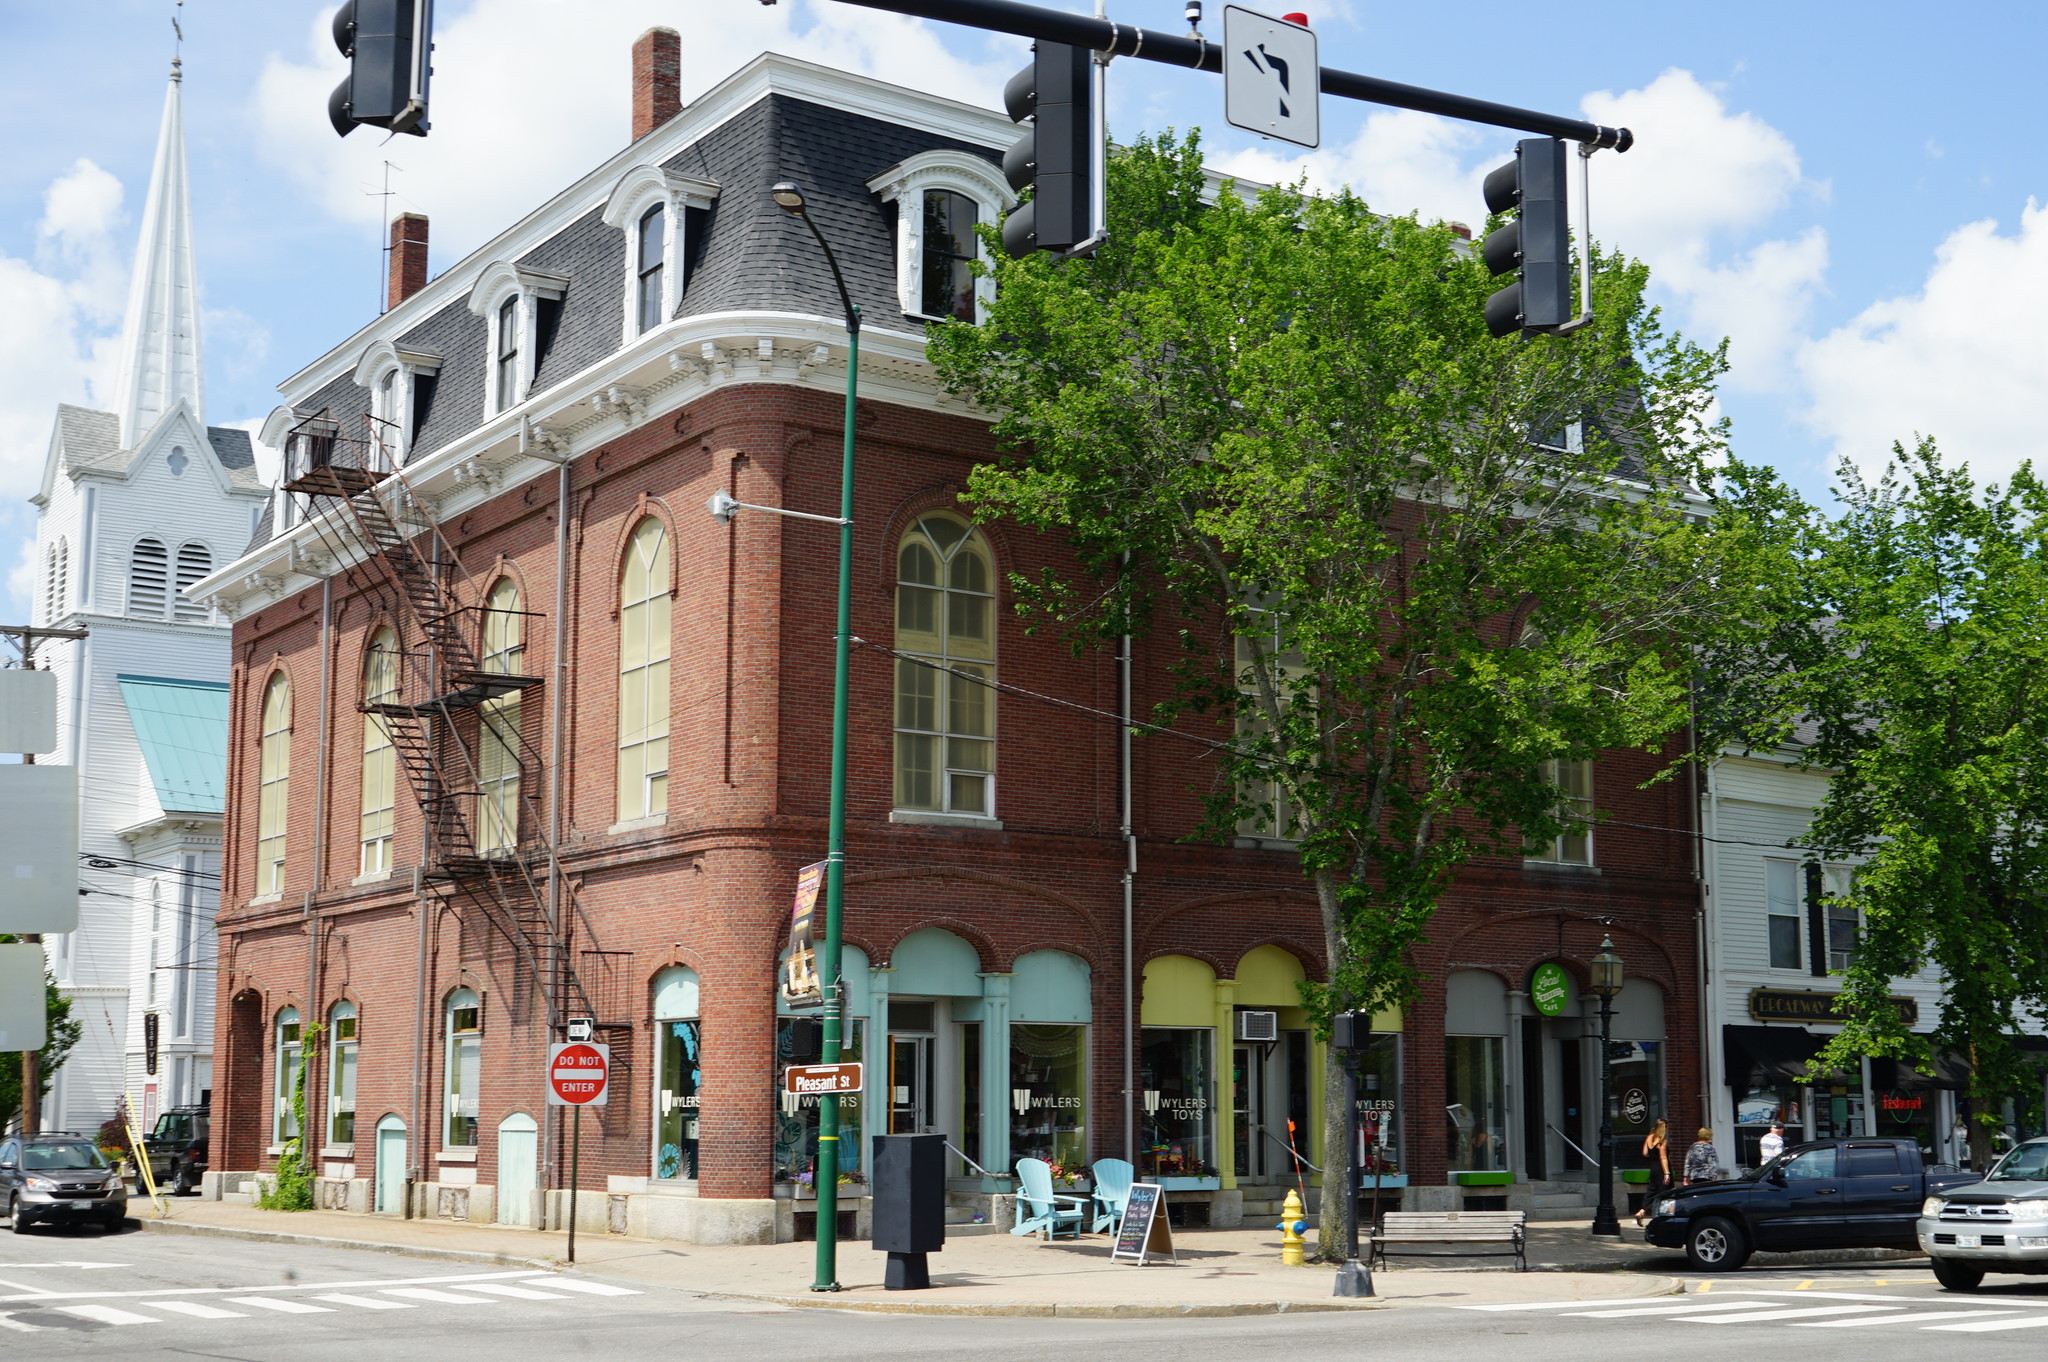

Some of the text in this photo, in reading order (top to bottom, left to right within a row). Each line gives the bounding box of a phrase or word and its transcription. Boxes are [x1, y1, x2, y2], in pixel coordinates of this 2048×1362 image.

[1759, 998, 1825, 1014] BROADWAY
[559, 1056, 600, 1066] DO NOT
[562, 1083, 595, 1092] ENTER
[795, 1075, 850, 1091] Pleasant St
[801, 1096, 857, 1107] WYR'S
[1031, 1097, 1081, 1108] WYLER'S
[1160, 1098, 1207, 1109] WYLER'S
[1172, 1109, 1203, 1120] TOYS
